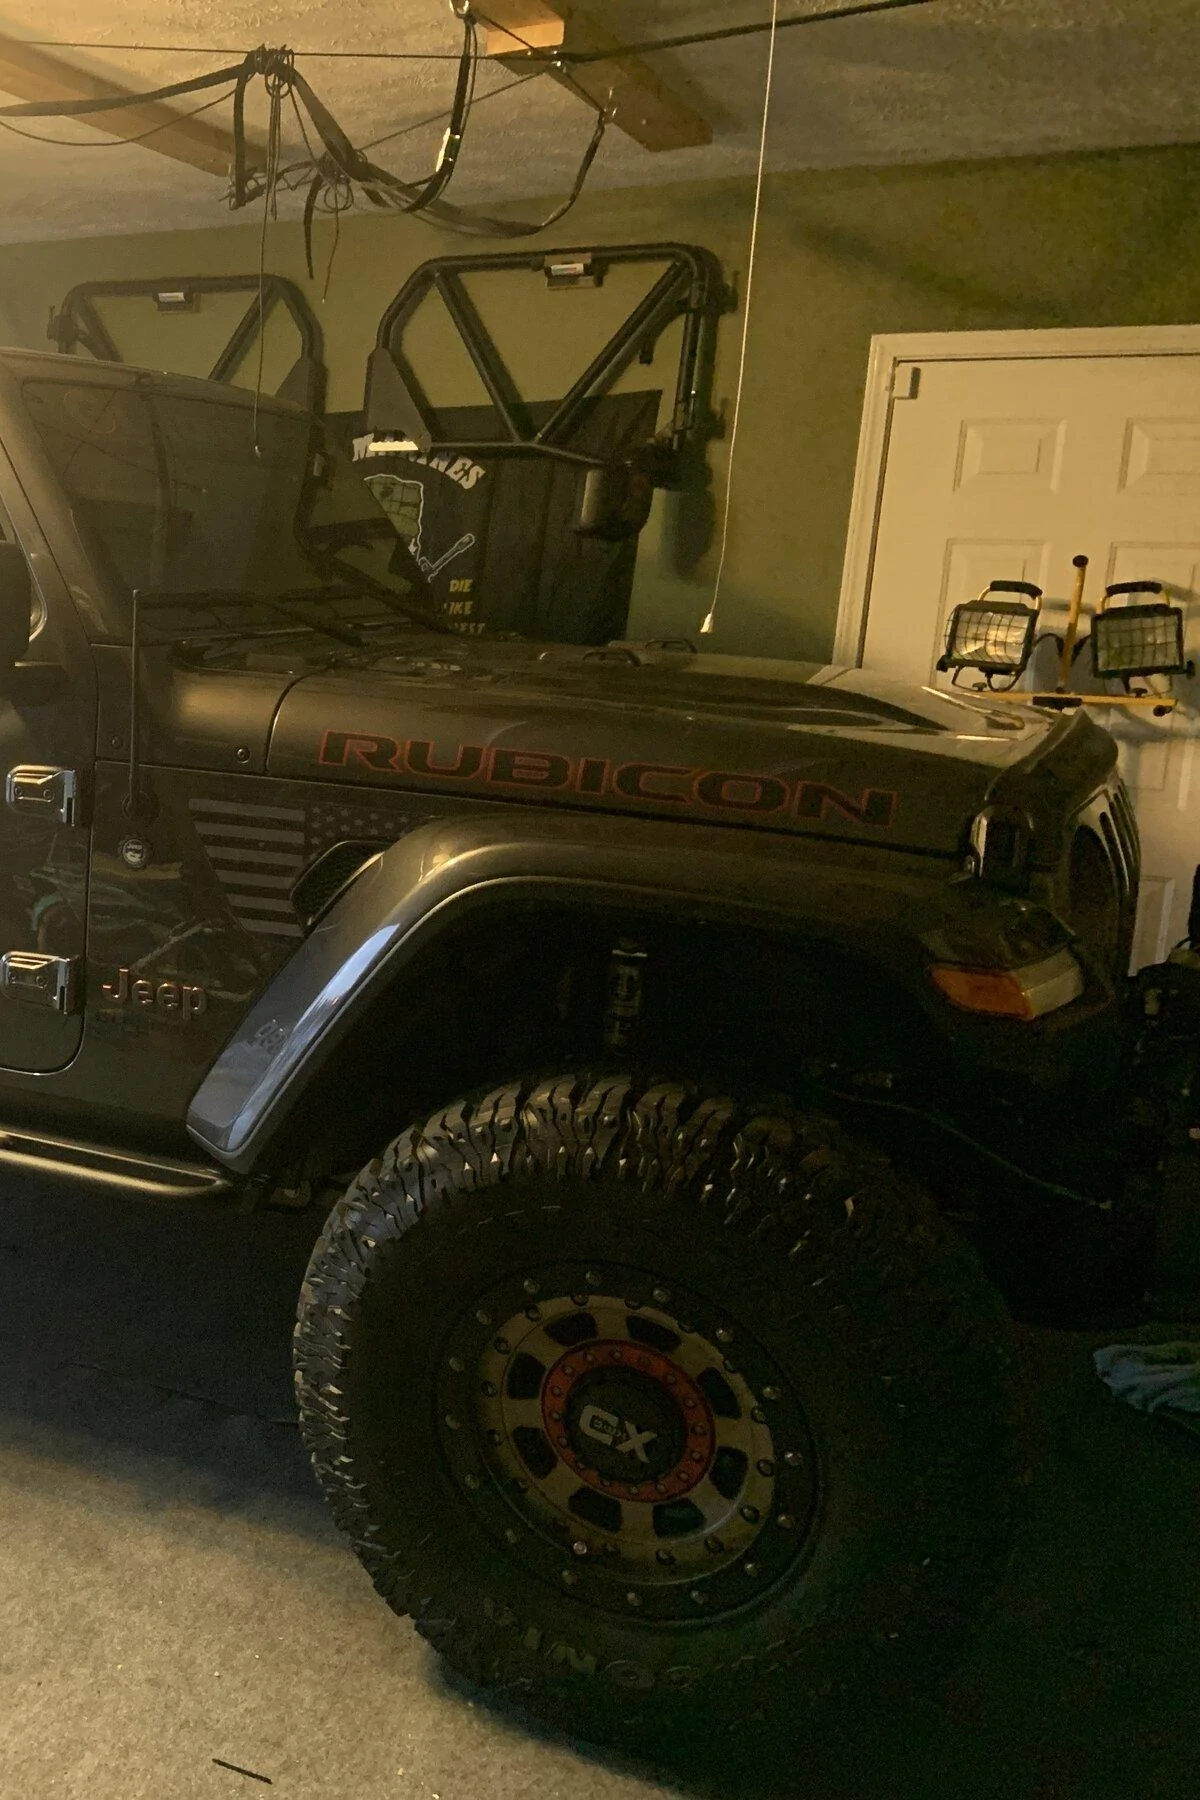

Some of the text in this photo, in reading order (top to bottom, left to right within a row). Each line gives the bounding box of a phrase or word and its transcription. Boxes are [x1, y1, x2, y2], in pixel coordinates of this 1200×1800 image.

[352, 433, 486, 490] MNES
[449, 579, 473, 592] DIE
[317, 729, 898, 828] RUBICON
[101, 966, 208, 1020] Jeep
